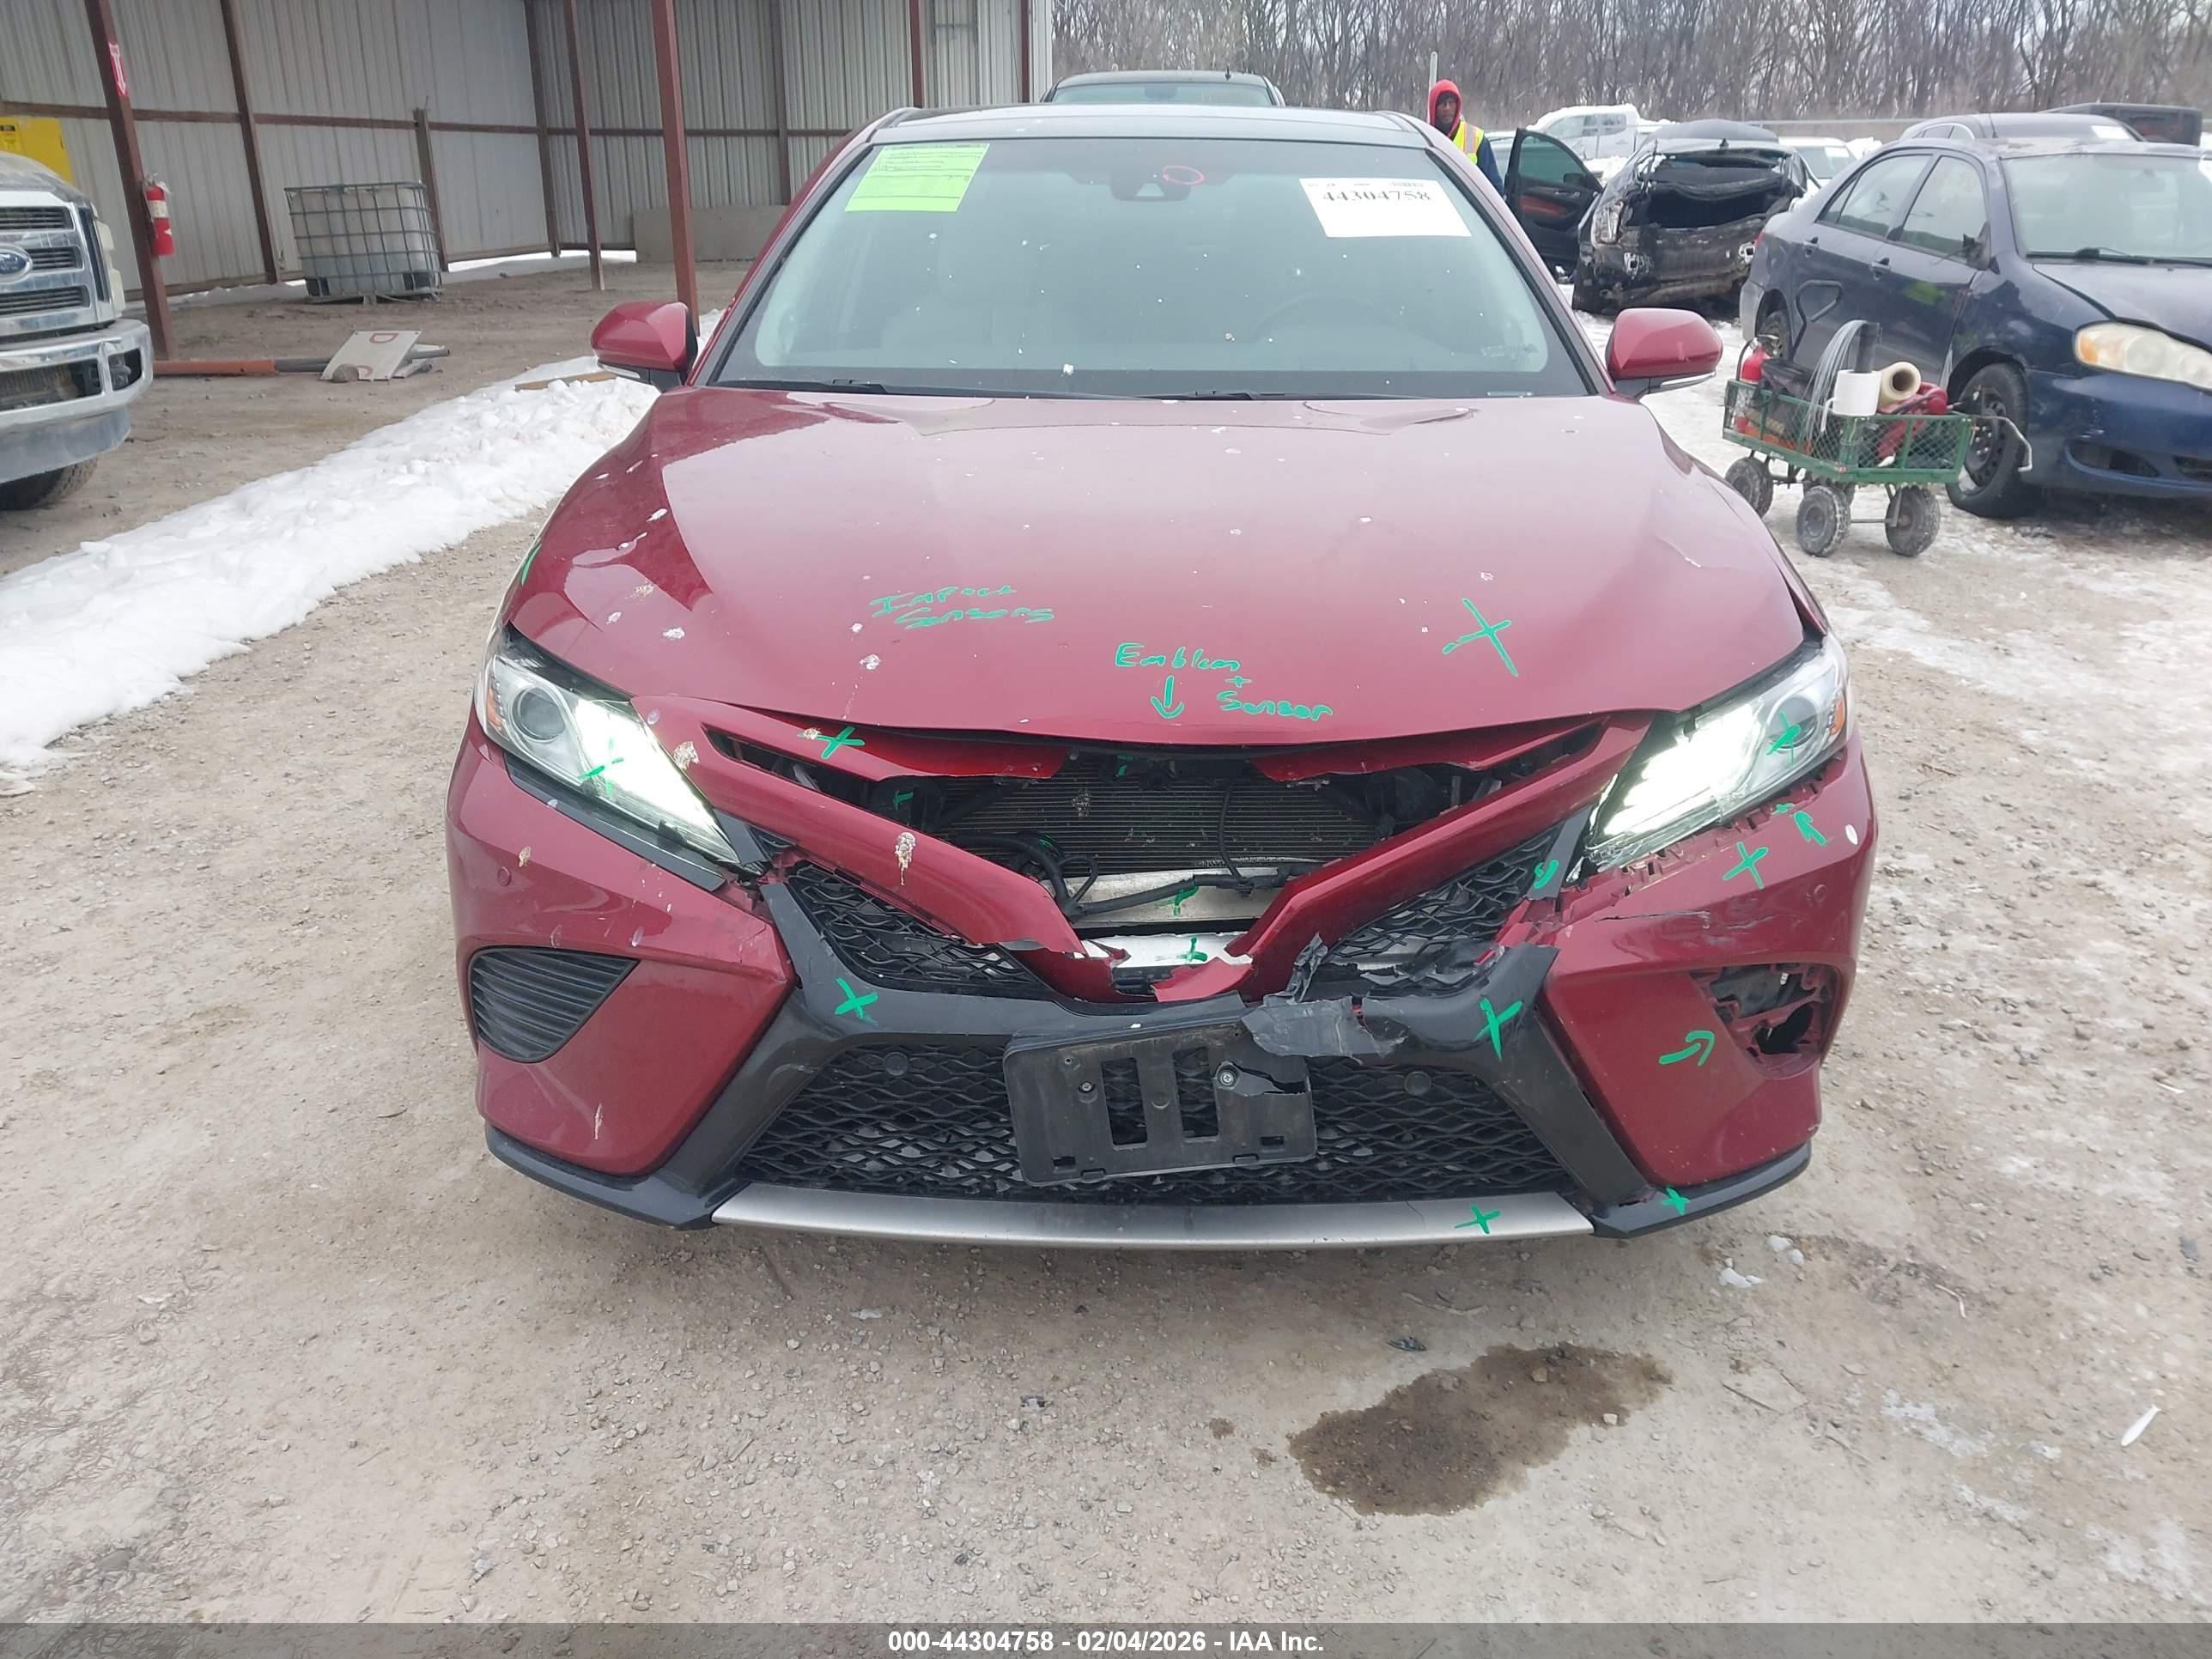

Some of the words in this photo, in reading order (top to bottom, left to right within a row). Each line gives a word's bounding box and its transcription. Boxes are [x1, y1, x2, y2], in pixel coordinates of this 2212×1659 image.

[1322, 190, 1431, 202] 44304758
[893, 606, 1054, 629] Sensors
[1216, 690, 1333, 721] Sensor
